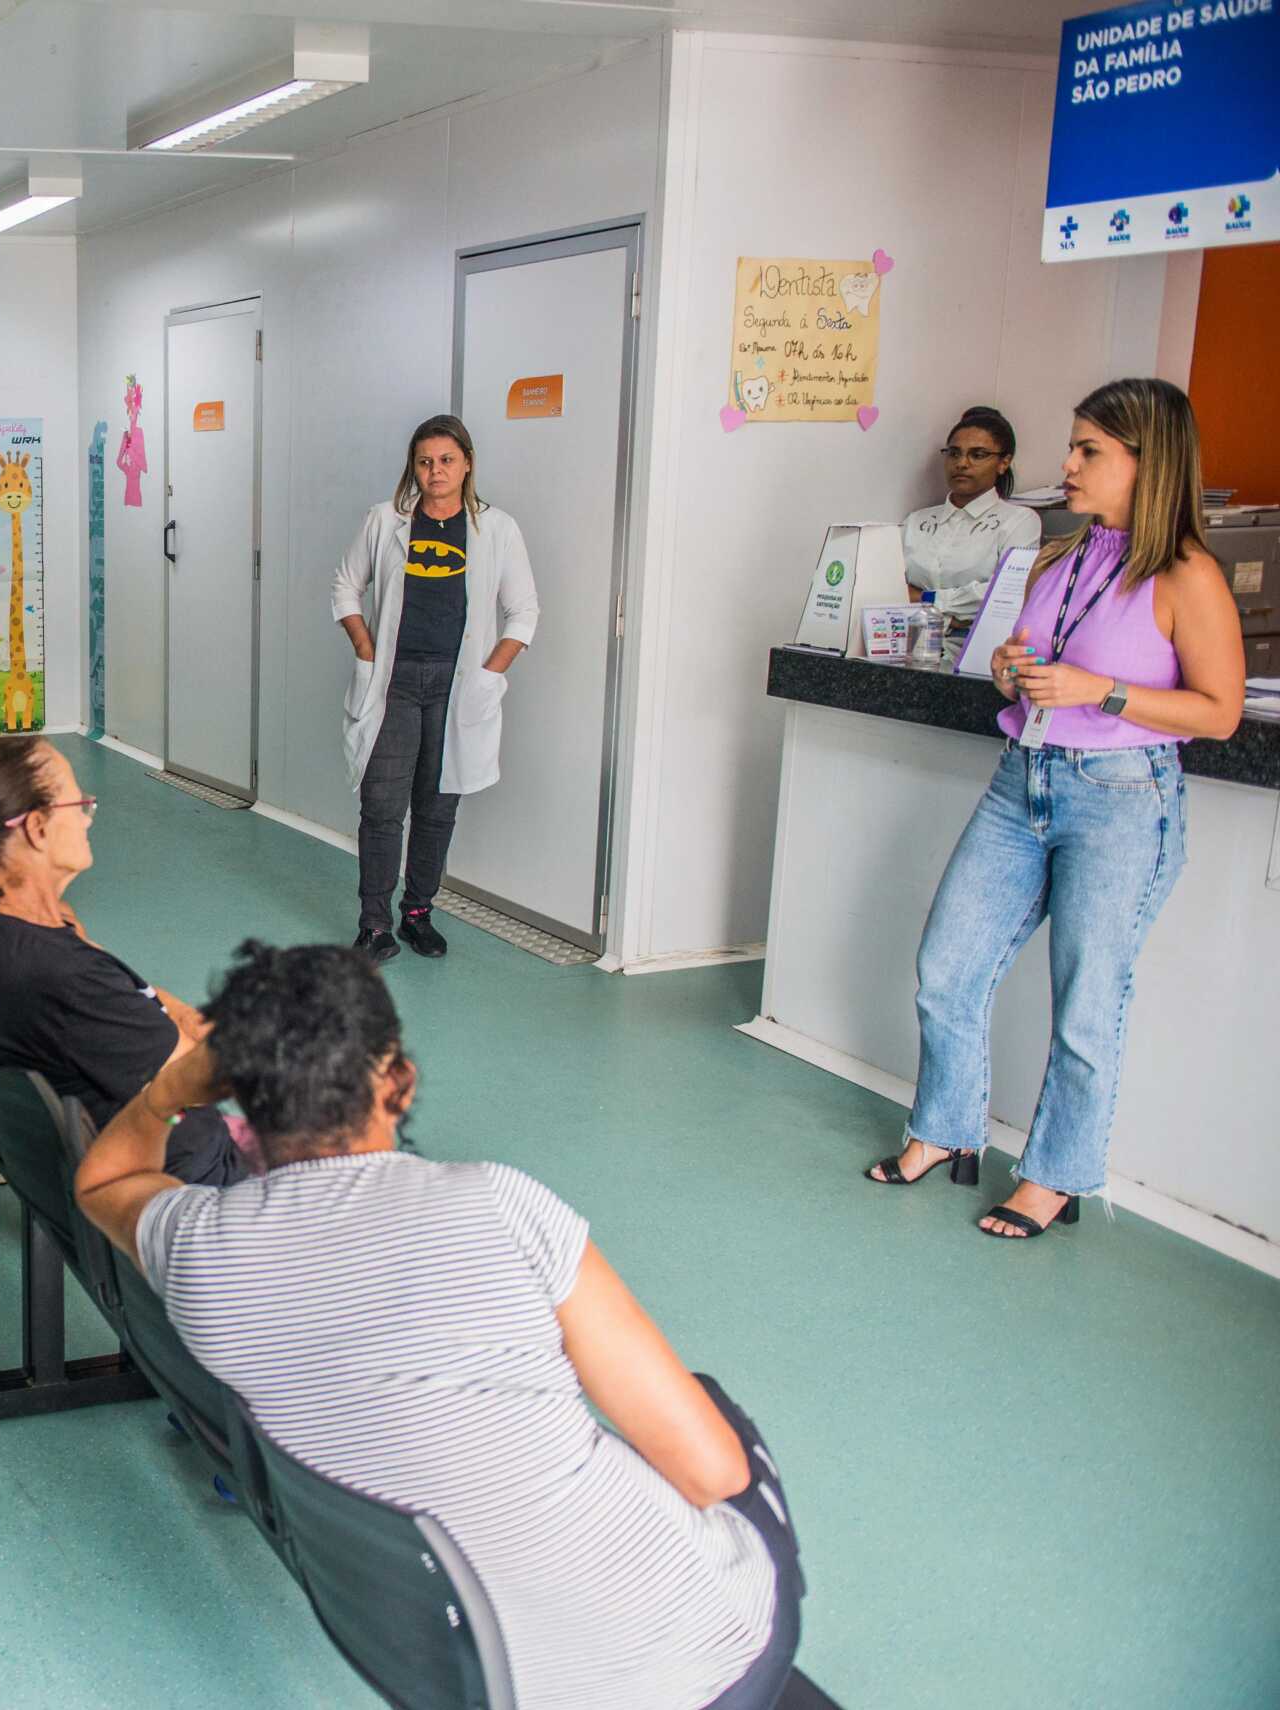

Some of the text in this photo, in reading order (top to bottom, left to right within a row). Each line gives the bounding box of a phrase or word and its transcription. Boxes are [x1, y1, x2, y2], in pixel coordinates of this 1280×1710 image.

[1077, 18, 1161, 51] UNIDADE
[1167, 9, 1195, 32] DE
[1074, 40, 1183, 78] DA FAMÍLIA
[1071, 66, 1182, 104] SÃO PEDRO
[1060, 241, 1076, 250] SUS
[759, 265, 837, 299] Dentista
[743, 305, 792, 338] Segunda
[816, 307, 852, 331] Sexta
